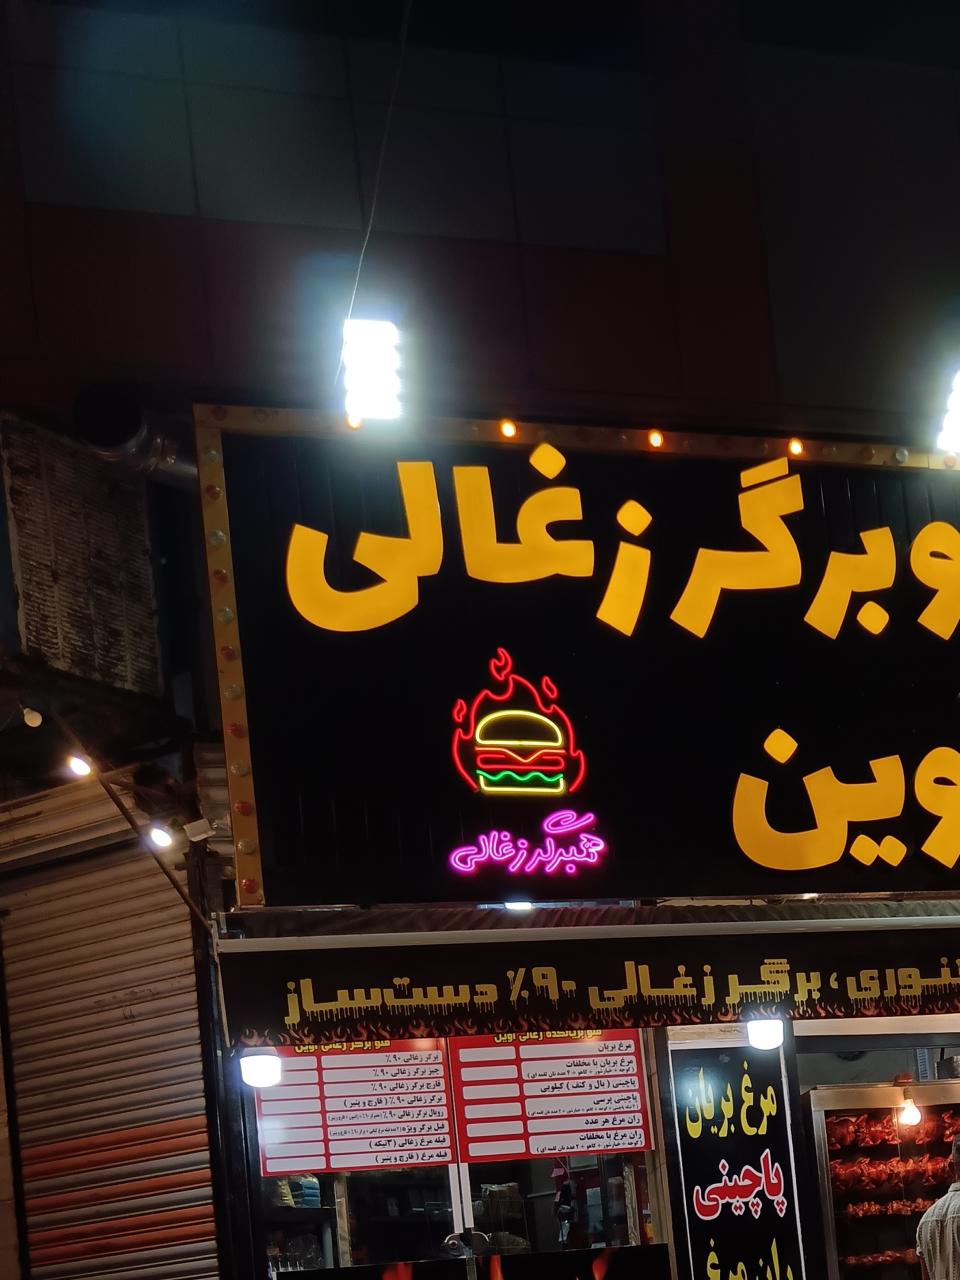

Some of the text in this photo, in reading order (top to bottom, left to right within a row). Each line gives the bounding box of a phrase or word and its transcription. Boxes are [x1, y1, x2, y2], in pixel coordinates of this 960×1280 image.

[285, 442, 653, 637] زغالی
[669, 457, 897, 640] برگر
[451, 809, 605, 873] همبرگر زغالی
[588, 960, 715, 1013] زغالی
[725, 958, 820, 1013] برگر
[598, 1042, 632, 1052] مرغ بریان
[600, 1058, 618, 1067] بریان
[619, 1057, 633, 1066] مرغ
[612, 1078, 636, 1088] پاچینی
[686, 1061, 777, 1139] مرغ بریان
[601, 1118, 609, 1126] هر
[611, 1116, 625, 1125] مرغ
[627, 1115, 640, 1124] ران
[613, 1131, 627, 1140] مرغ
[629, 1130, 642, 1140] ران
[420, 1137, 433, 1146] مرغ
[421, 1152, 434, 1160] مرغ
[693, 1148, 787, 1220] پاچینی
